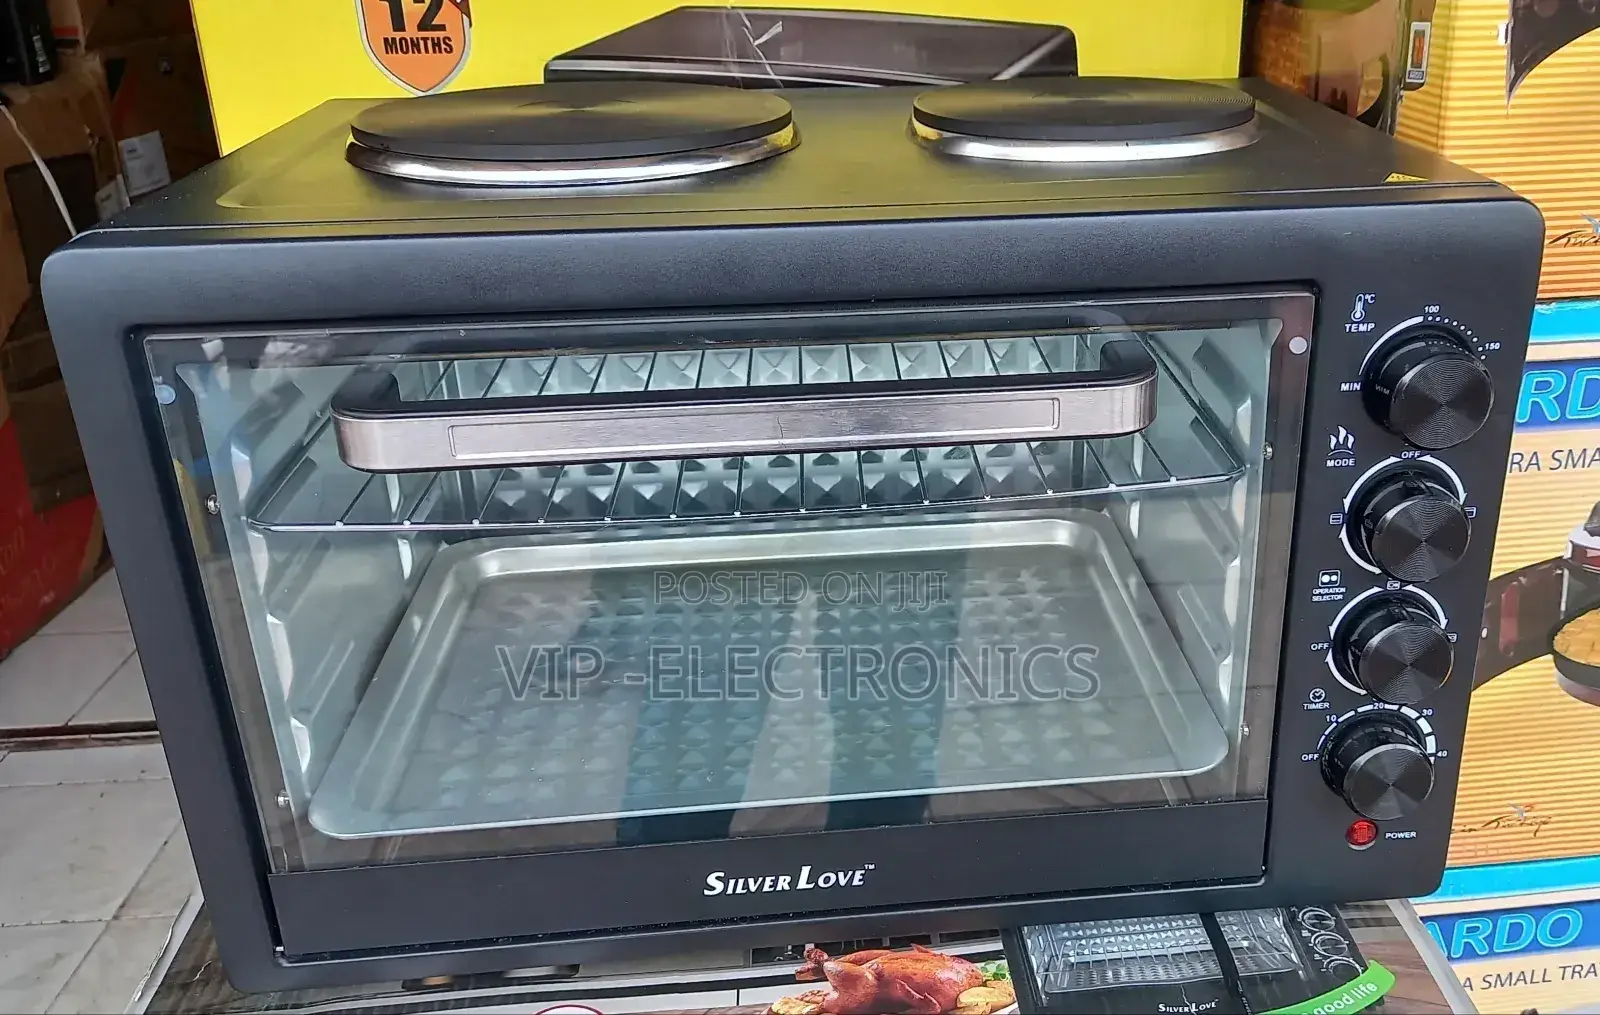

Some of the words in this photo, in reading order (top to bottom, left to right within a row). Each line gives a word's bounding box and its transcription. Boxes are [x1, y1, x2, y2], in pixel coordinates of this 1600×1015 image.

[382, 0, 447, 32] 12
[383, 36, 454, 55] MONTHS
[1424, 305, 1440, 314] 100
[1344, 323, 1375, 333] TEMP
[1484, 342, 1501, 350] 150
[1340, 382, 1361, 392] MIN
[1401, 450, 1421, 459] OFF
[1326, 458, 1356, 467] MODE
[1508, 450, 1542, 474] RA
[1312, 587, 1346, 595] OPERATION
[1312, 594, 1343, 602] SELECTOR
[1310, 643, 1330, 651] OFF
[1373, 702, 1384, 710] 20
[1422, 708, 1433, 716] 30
[1326, 715, 1337, 723] 10
[1301, 753, 1320, 761] OFF
[1385, 831, 1417, 839] POWER
[703, 871, 792, 896] SILVER
[796, 865, 866, 890] LOVE
[1480, 968, 1553, 991] SMALL
[1350, 982, 1378, 999] life
